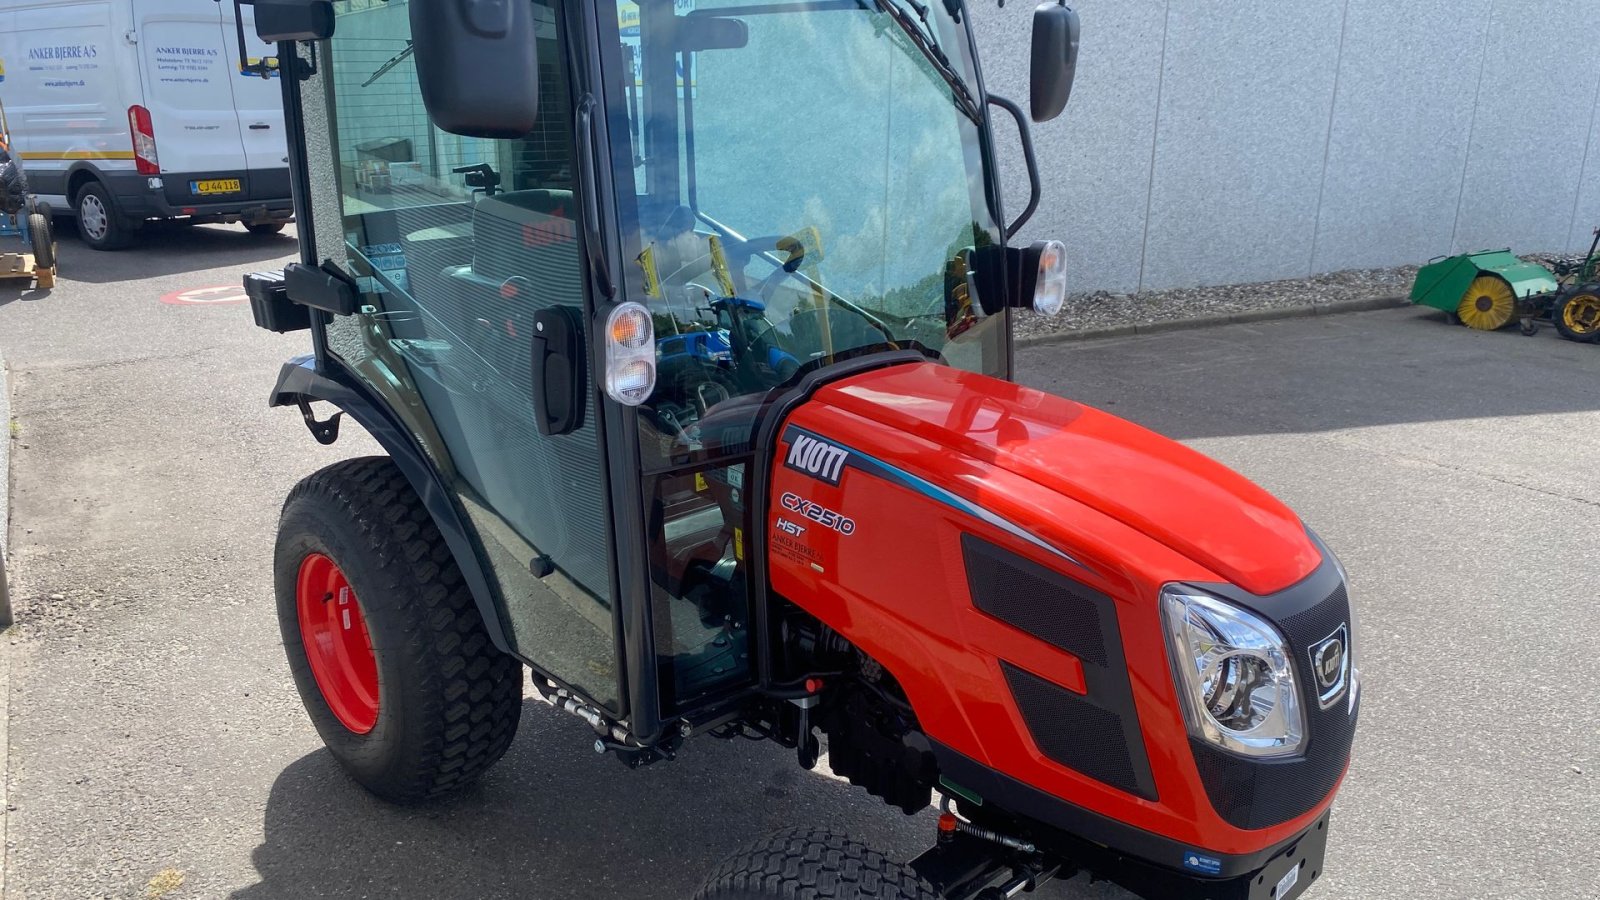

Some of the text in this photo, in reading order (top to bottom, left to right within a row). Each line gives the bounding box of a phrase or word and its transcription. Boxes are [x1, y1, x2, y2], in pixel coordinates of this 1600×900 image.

[29, 44, 97, 61] ANKER BJERRE A/S
[156, 47, 218, 56] ANKER BJERRE A/S
[198, 180, 239, 192] CJ 44 118
[787, 434, 849, 482] KIOTI
[780, 491, 856, 536] CX2510
[775, 517, 806, 537] HST
